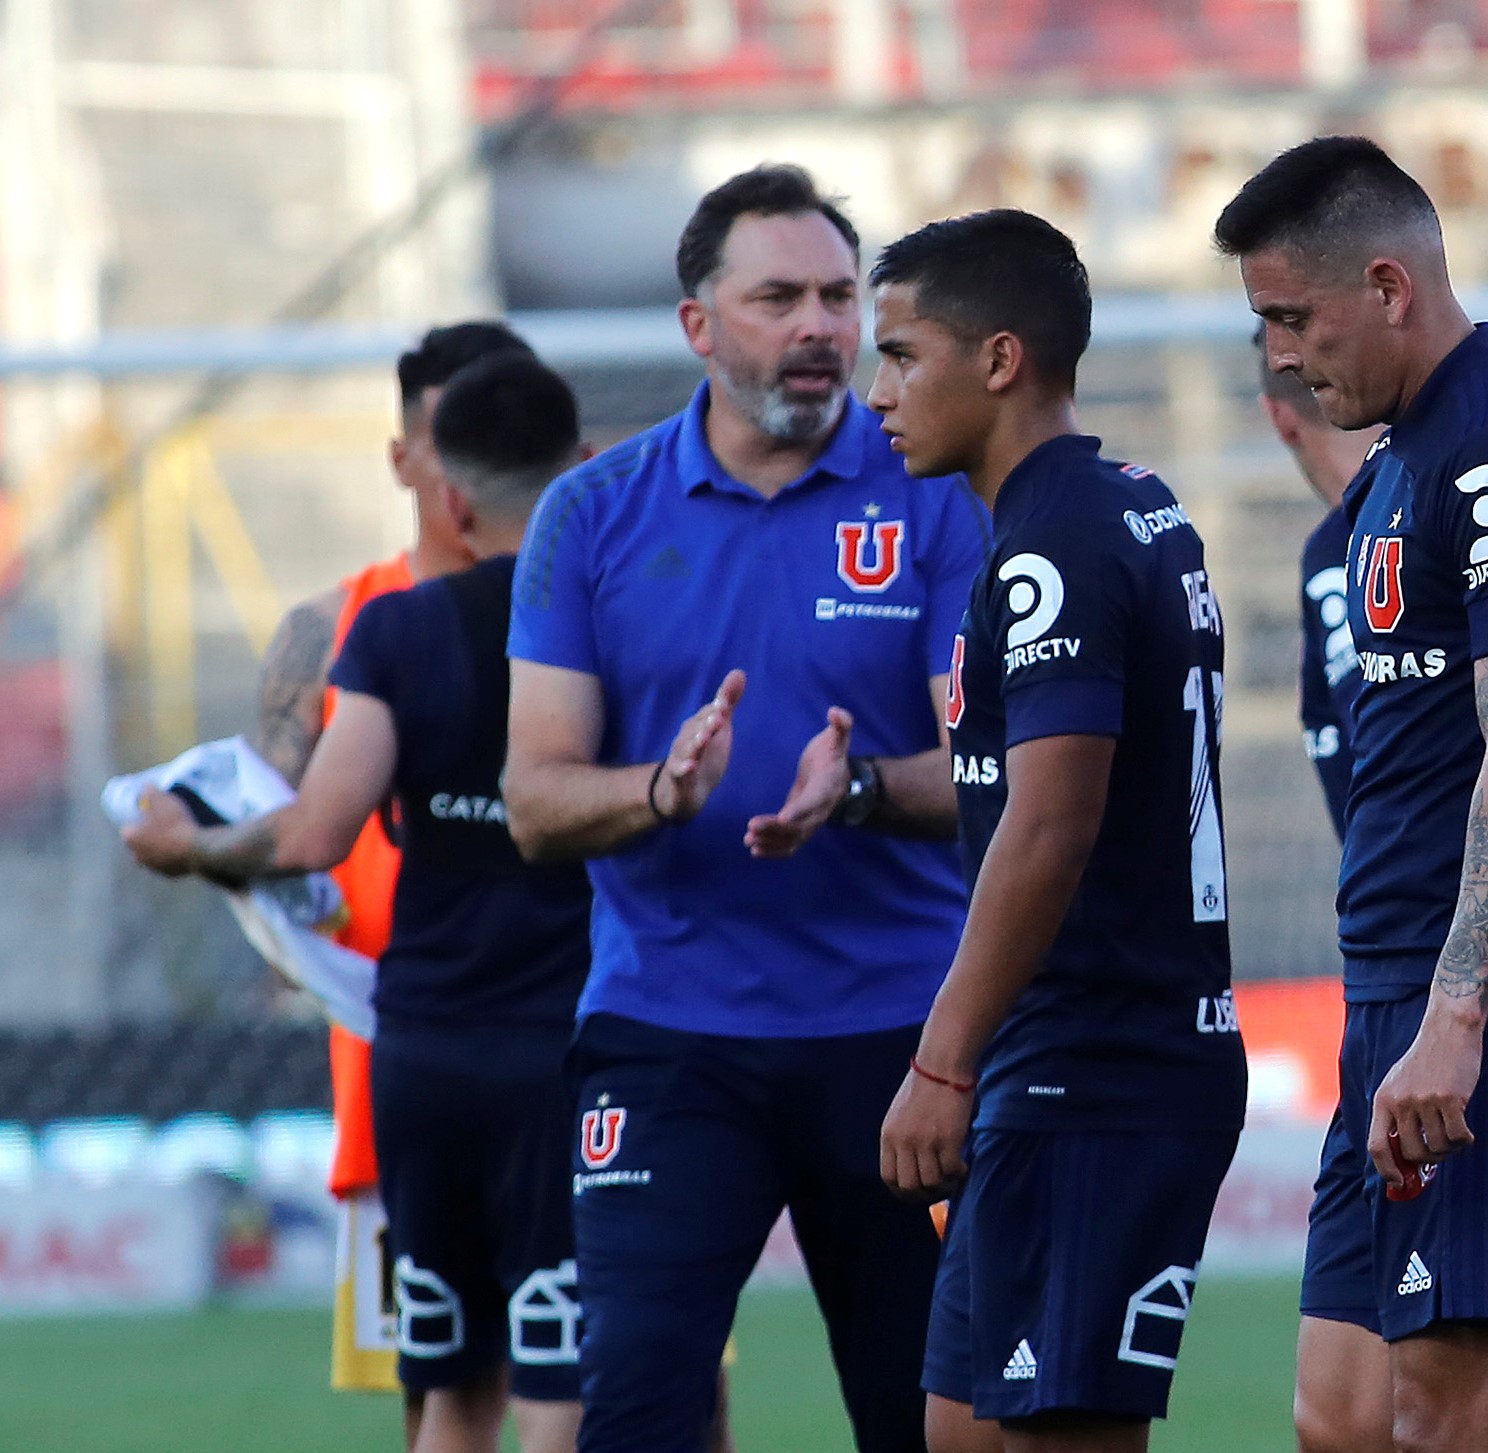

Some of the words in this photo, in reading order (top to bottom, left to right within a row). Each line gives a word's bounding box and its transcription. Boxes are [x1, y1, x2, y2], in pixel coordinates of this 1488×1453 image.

[835, 519, 905, 594] U
[1364, 537, 1404, 633] U
[1003, 637, 1081, 675] DIRECTV
[580, 1106, 628, 1170] U
